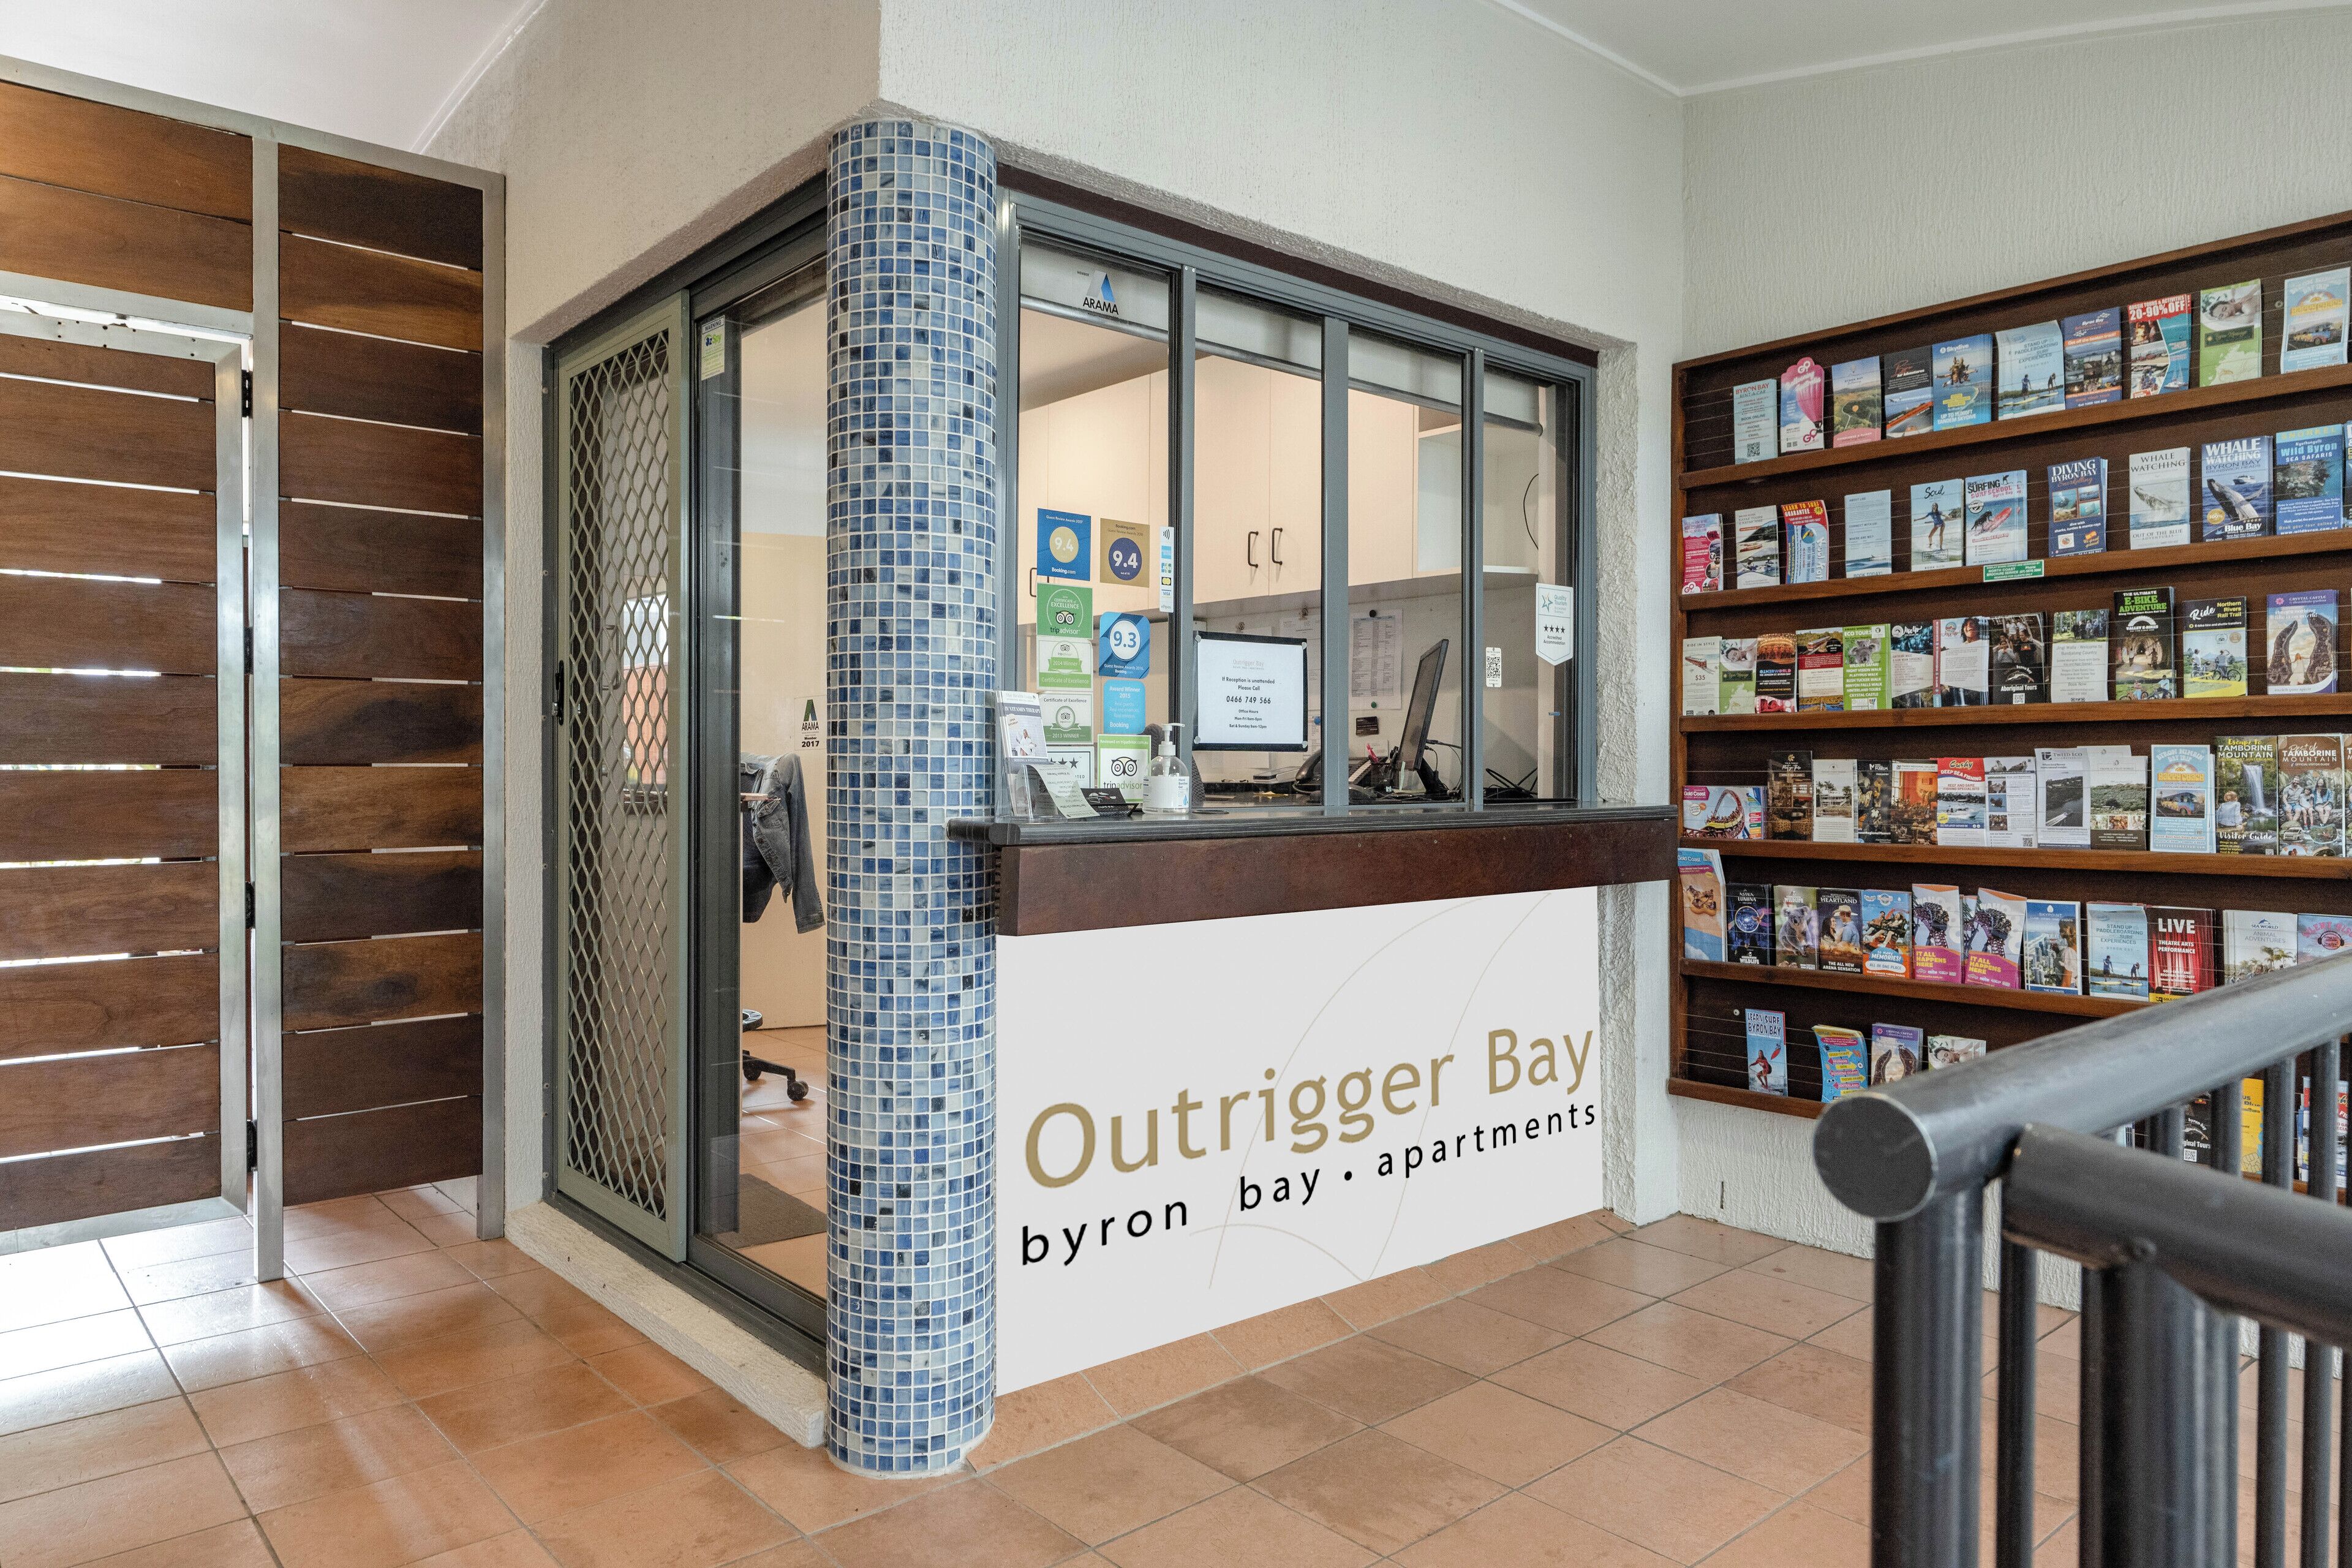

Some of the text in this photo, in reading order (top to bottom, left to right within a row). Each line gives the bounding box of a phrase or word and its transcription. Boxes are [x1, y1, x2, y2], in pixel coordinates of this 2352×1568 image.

[1083, 297, 1118, 315] ARAMA
[705, 320, 722, 331] WARNING
[1947, 344, 1969, 353] Skydive
[2015, 342, 2059, 355] PADDLEBOARDING
[1736, 386, 1756, 394] BYRON
[2205, 438, 2261, 457] WHALE
[2280, 442, 2337, 456] Wild Byron
[2141, 453, 2175, 462] WHALE
[2206, 450, 2261, 465] WATCHING
[2052, 459, 2096, 477] DIVING
[2130, 459, 2185, 472] WATCHING
[2051, 471, 2080, 483] BYRON
[1924, 485, 1945, 499] Soul
[1967, 479, 2000, 494] SURFING
[1785, 508, 1810, 517] GUARANTEE
[2246, 522, 2261, 532] Bay
[1054, 537, 1074, 552] 9.4
[1112, 550, 1138, 568] 9.4
[1684, 584, 1695, 593] GO
[2124, 595, 2158, 605] E-BIKE
[2119, 603, 2167, 613] ADVENTURE
[2189, 606, 2216, 620] Ride
[1114, 630, 1137, 648] 9.3
[802, 722, 820, 731] ARAMA
[1103, 781, 1143, 790] tripadvisor
[2219, 832, 2274, 840] Visitor Guide
[2158, 918, 2195, 934] LIVE
[1871, 953, 1901, 962] MEMORIES!
[1969, 961, 2002, 973] HAPPENS
[1969, 966, 1986, 974] HERE
[1747, 1012, 1780, 1024] LEARN SURF
[1748, 1023, 1781, 1036] BYRON BAY
[1024, 1027, 1594, 1189] Outrigger Bay
[1021, 1104, 1596, 1266] byron bay apartments
